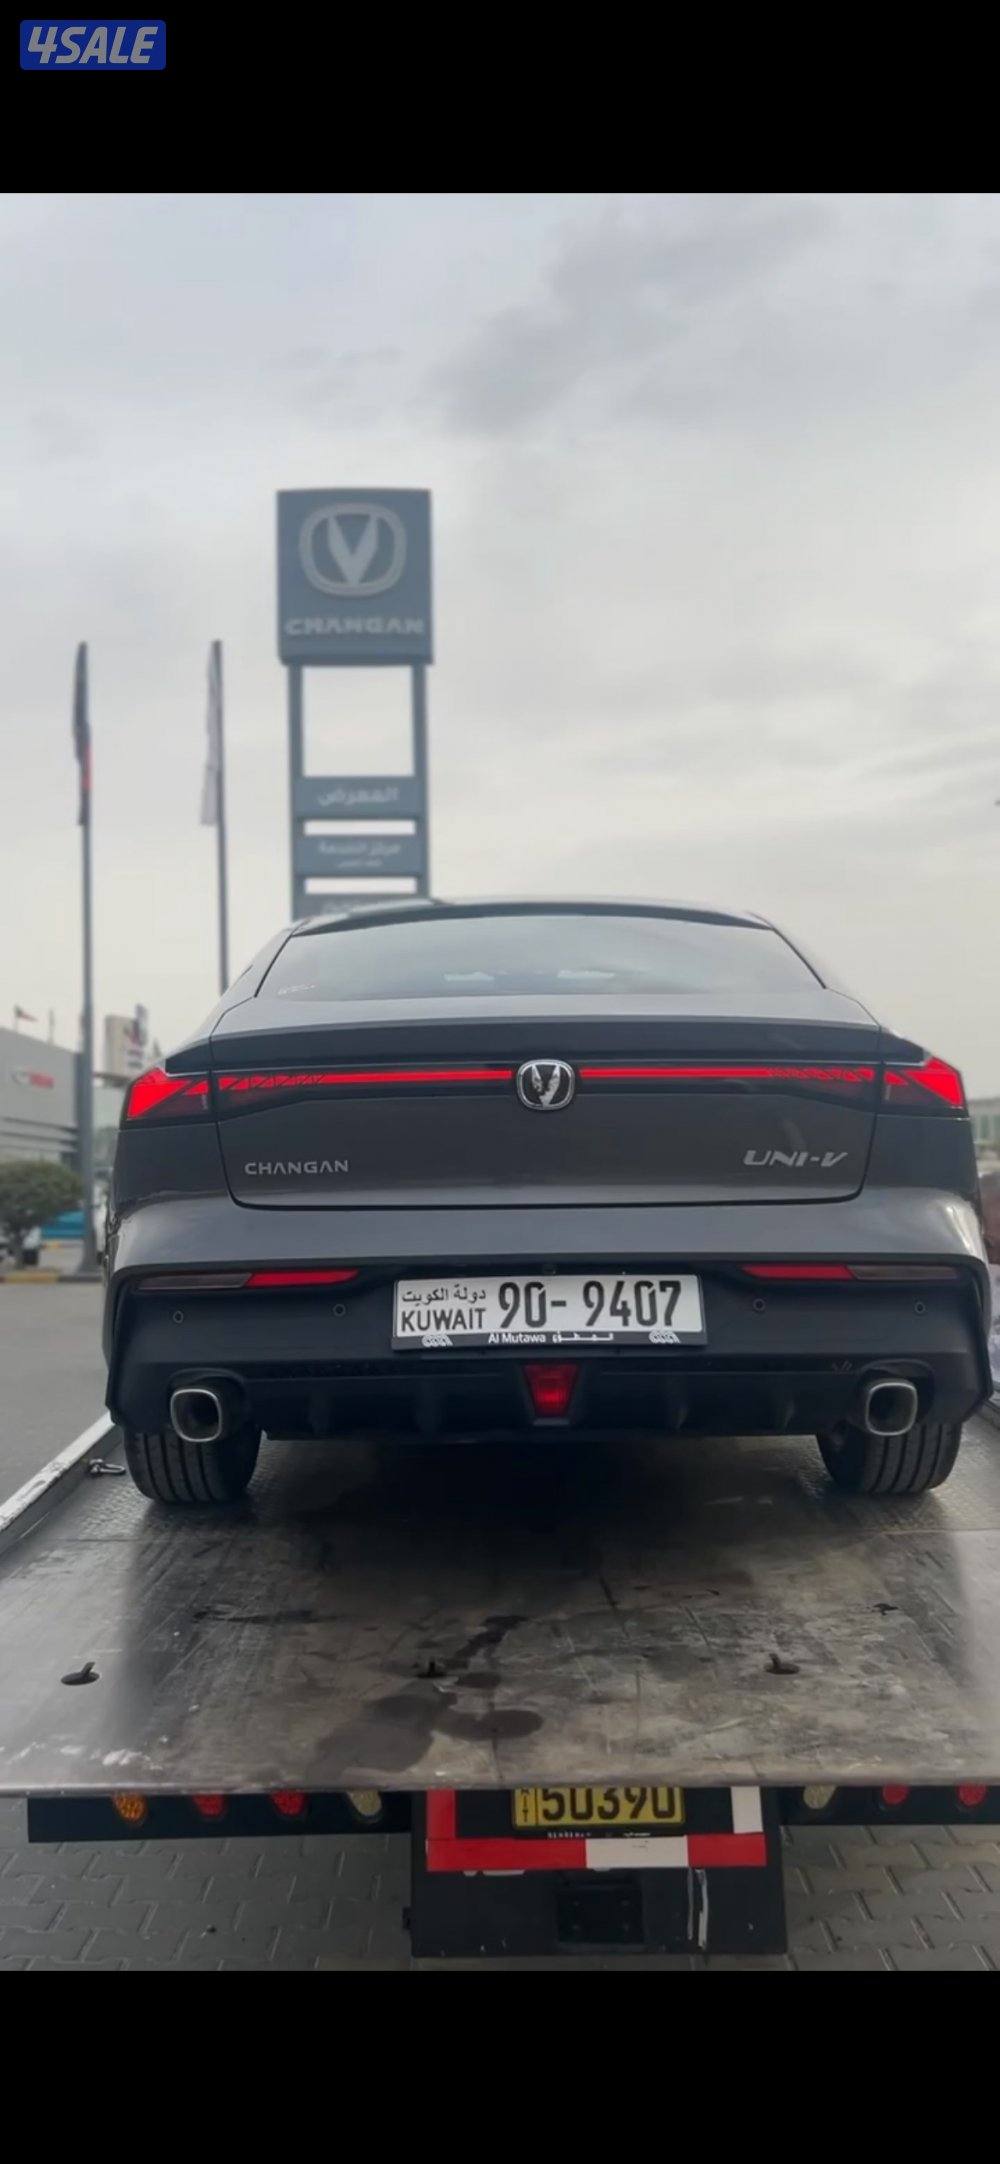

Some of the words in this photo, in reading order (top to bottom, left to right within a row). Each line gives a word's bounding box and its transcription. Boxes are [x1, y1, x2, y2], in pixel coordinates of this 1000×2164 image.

[286, 617, 424, 635] CHANGAN
[244, 1160, 349, 1175] CHANGAN
[743, 1150, 848, 1167] UNI-V
[402, 1287, 449, 1307] الكويت
[453, 1283, 487, 1304] دولة
[582, 1280, 682, 1327] 9407
[401, 1308, 487, 1332] KUWAIT
[488, 1332, 500, 1344] Al
[501, 1330, 546, 1343] Mutawa
[541, 1786, 676, 1821] 50390
